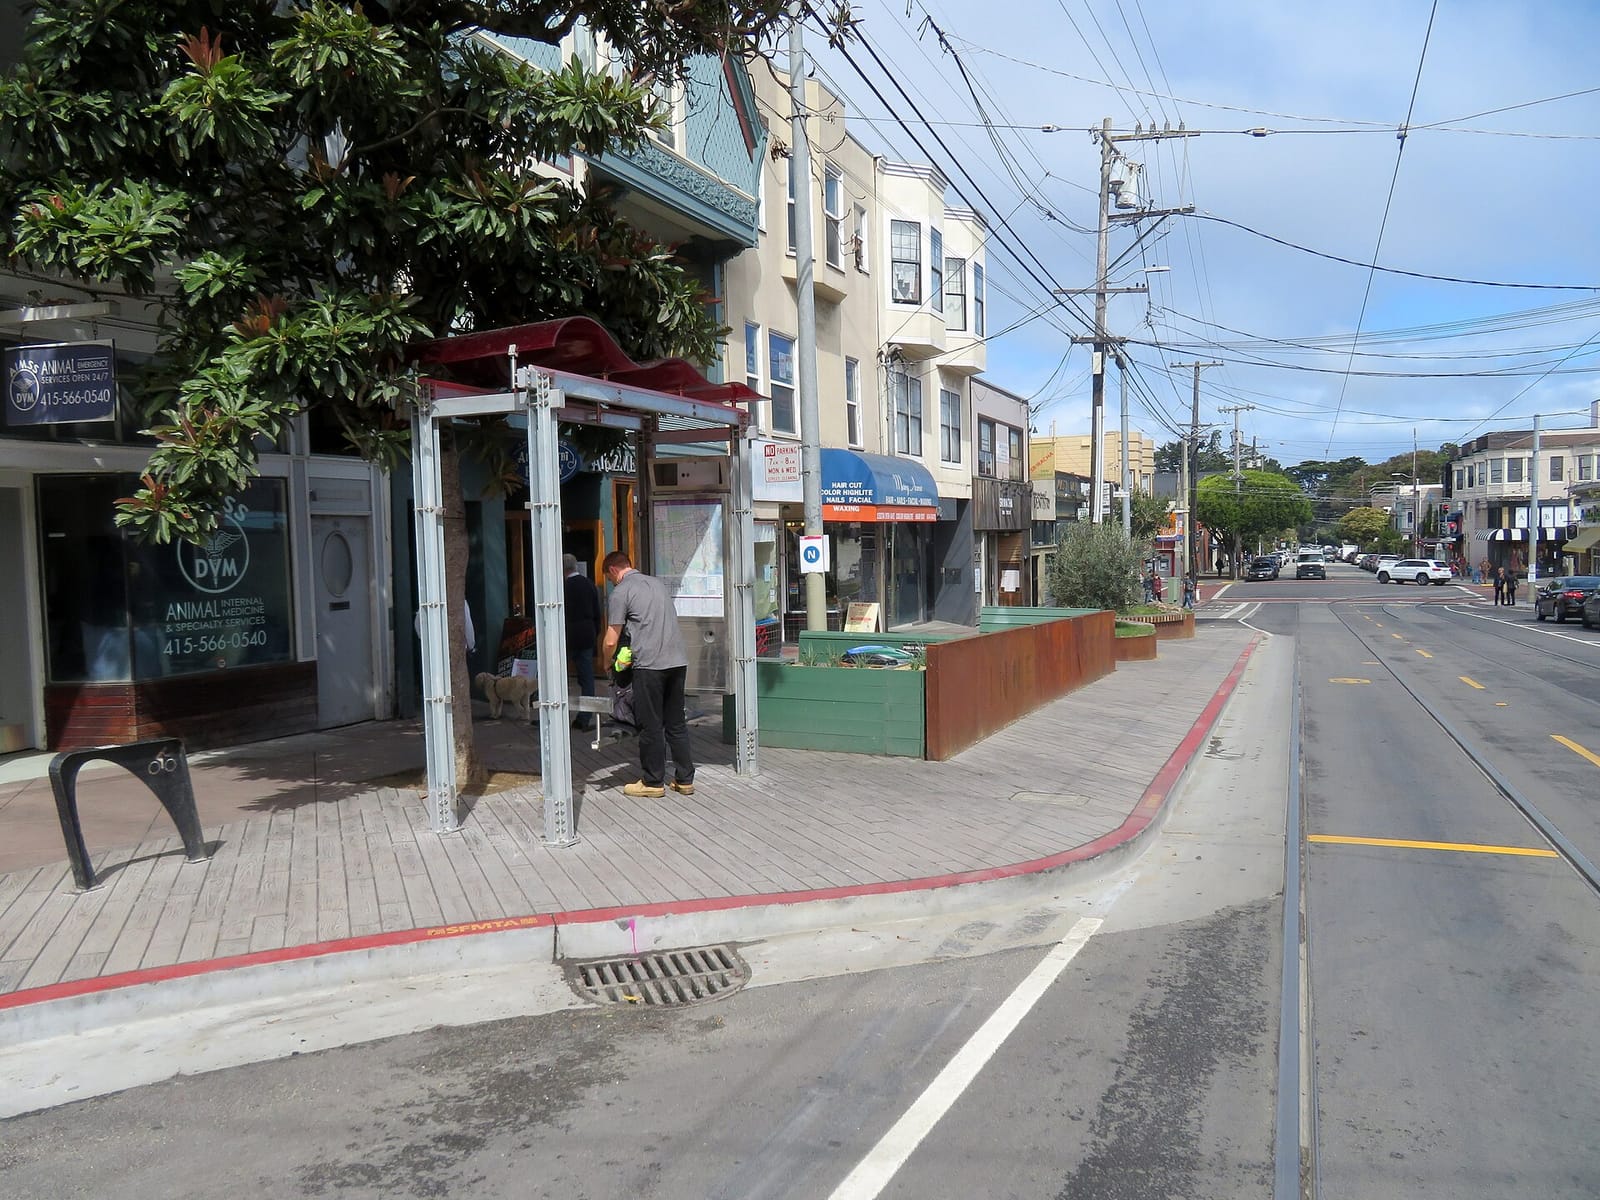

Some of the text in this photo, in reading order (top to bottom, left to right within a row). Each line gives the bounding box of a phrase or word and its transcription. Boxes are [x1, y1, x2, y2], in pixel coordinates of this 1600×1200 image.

[41, 358, 108, 375] ANIMAL EMERGENCY
[41, 372, 108, 384] SERVICES OPEN 24/7
[16, 392, 34, 404] DVM
[40, 389, 110, 406] 415-566-0540
[766, 446, 774, 456] NO
[808, 550, 816, 560] N
[195, 558, 238, 578] DVM
[166, 597, 264, 621] ANIMAL INTERNAL
[222, 606, 264, 616] MEDICINE
[166, 616, 266, 632] & SPECIALTY SERVICES
[163, 630, 267, 656] 415-566-0540
[446, 920, 519, 934] SFMTA
